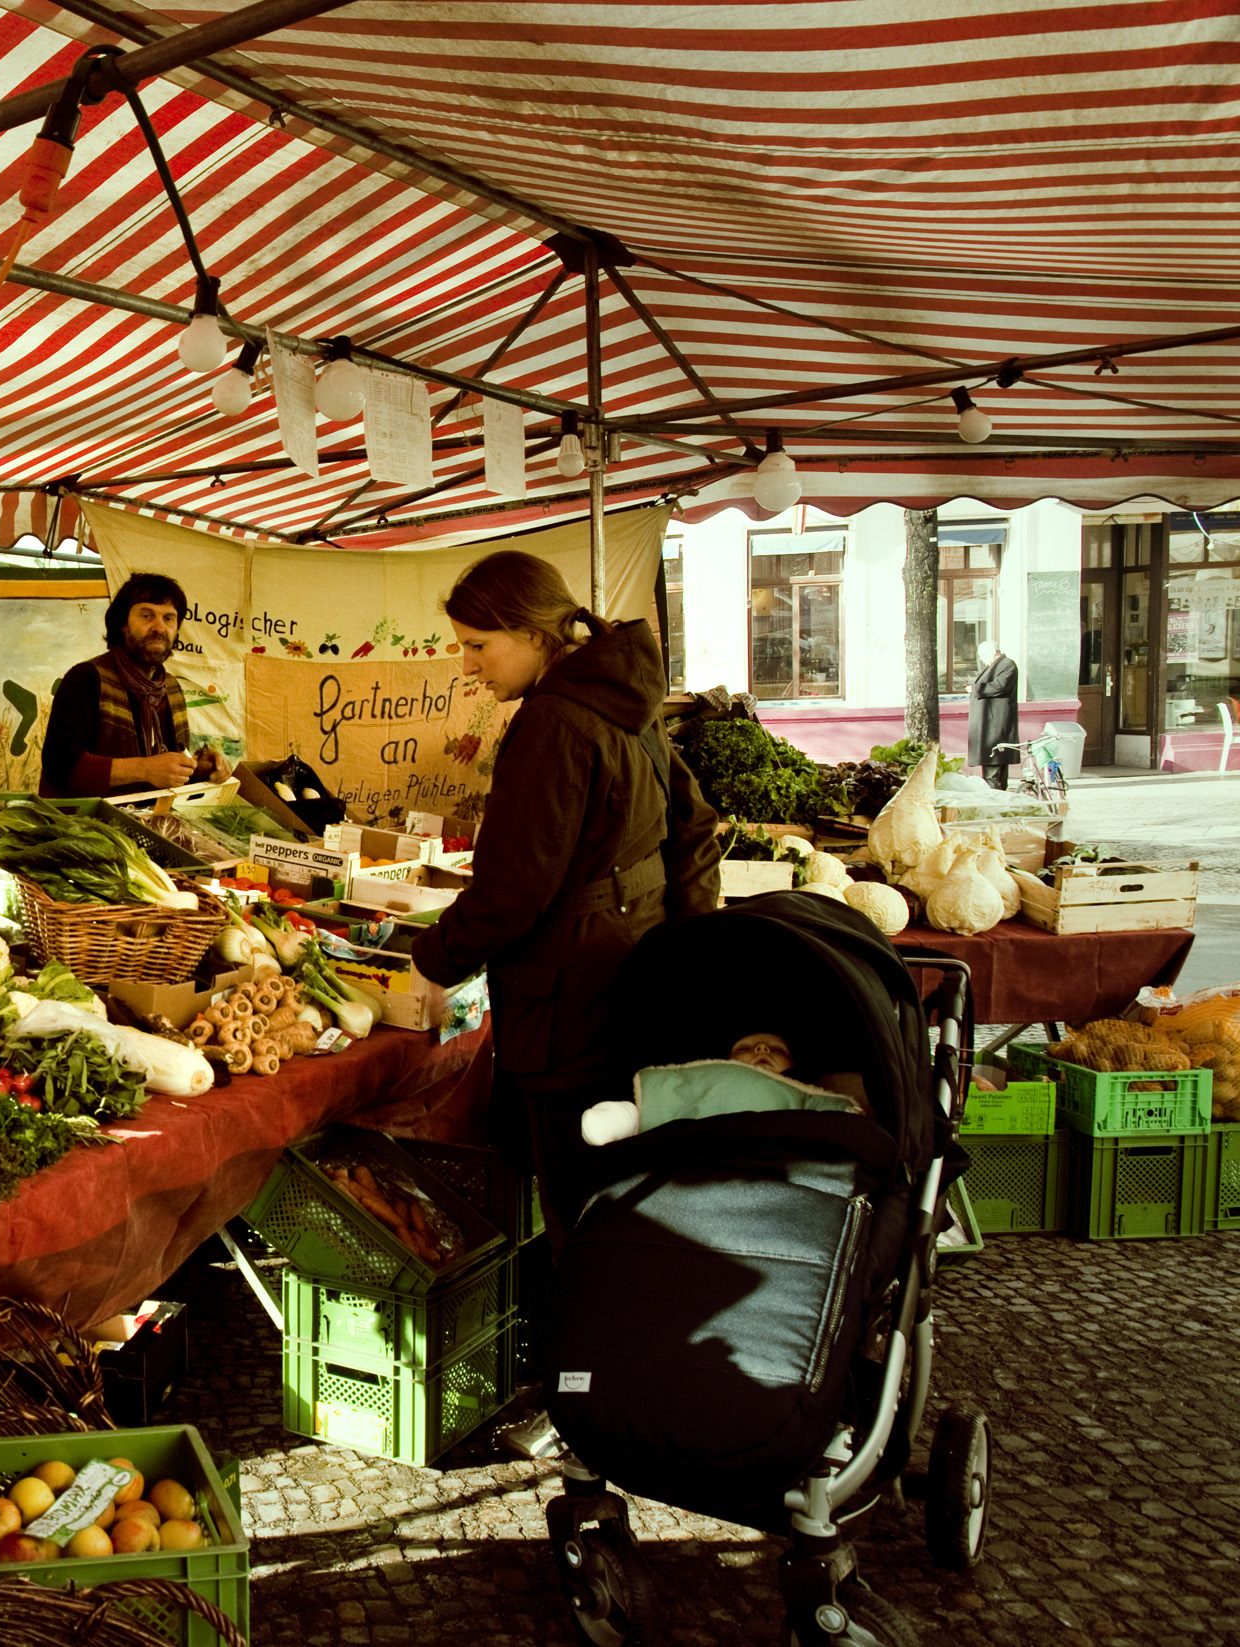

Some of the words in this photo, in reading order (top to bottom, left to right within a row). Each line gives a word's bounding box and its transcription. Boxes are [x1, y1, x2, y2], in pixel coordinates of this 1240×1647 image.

[422, 504, 507, 523] www.plana-schirme.de
[313, 673, 459, 765] Gärtnerhof
[380, 738, 418, 765] an
[265, 843, 310, 860] peppers
[313, 854, 343, 866] ORGANIC
